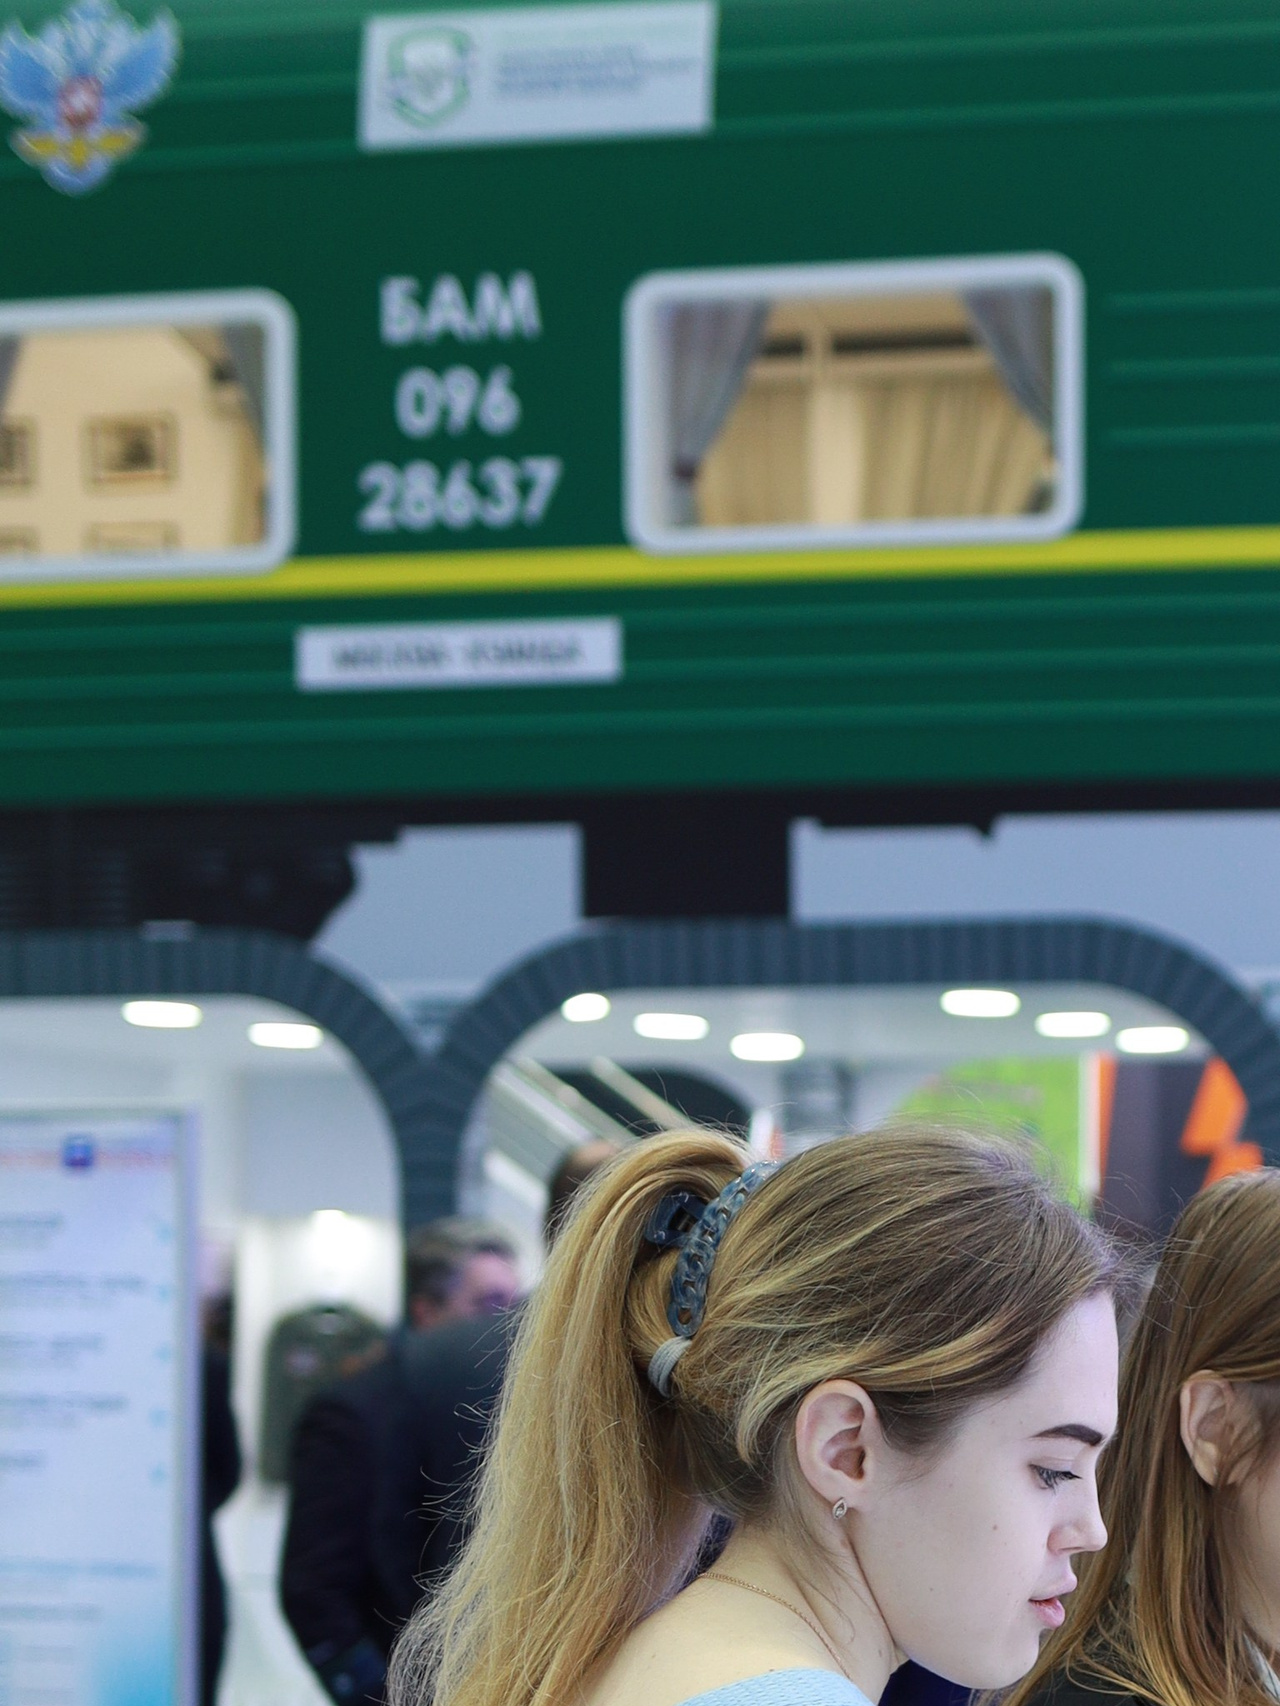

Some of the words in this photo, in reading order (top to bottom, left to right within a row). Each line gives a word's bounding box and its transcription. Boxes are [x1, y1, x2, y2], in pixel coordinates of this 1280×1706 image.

[379, 270, 542, 346] БАМ
[394, 364, 522, 440] 096
[357, 455, 563, 533] 28637
